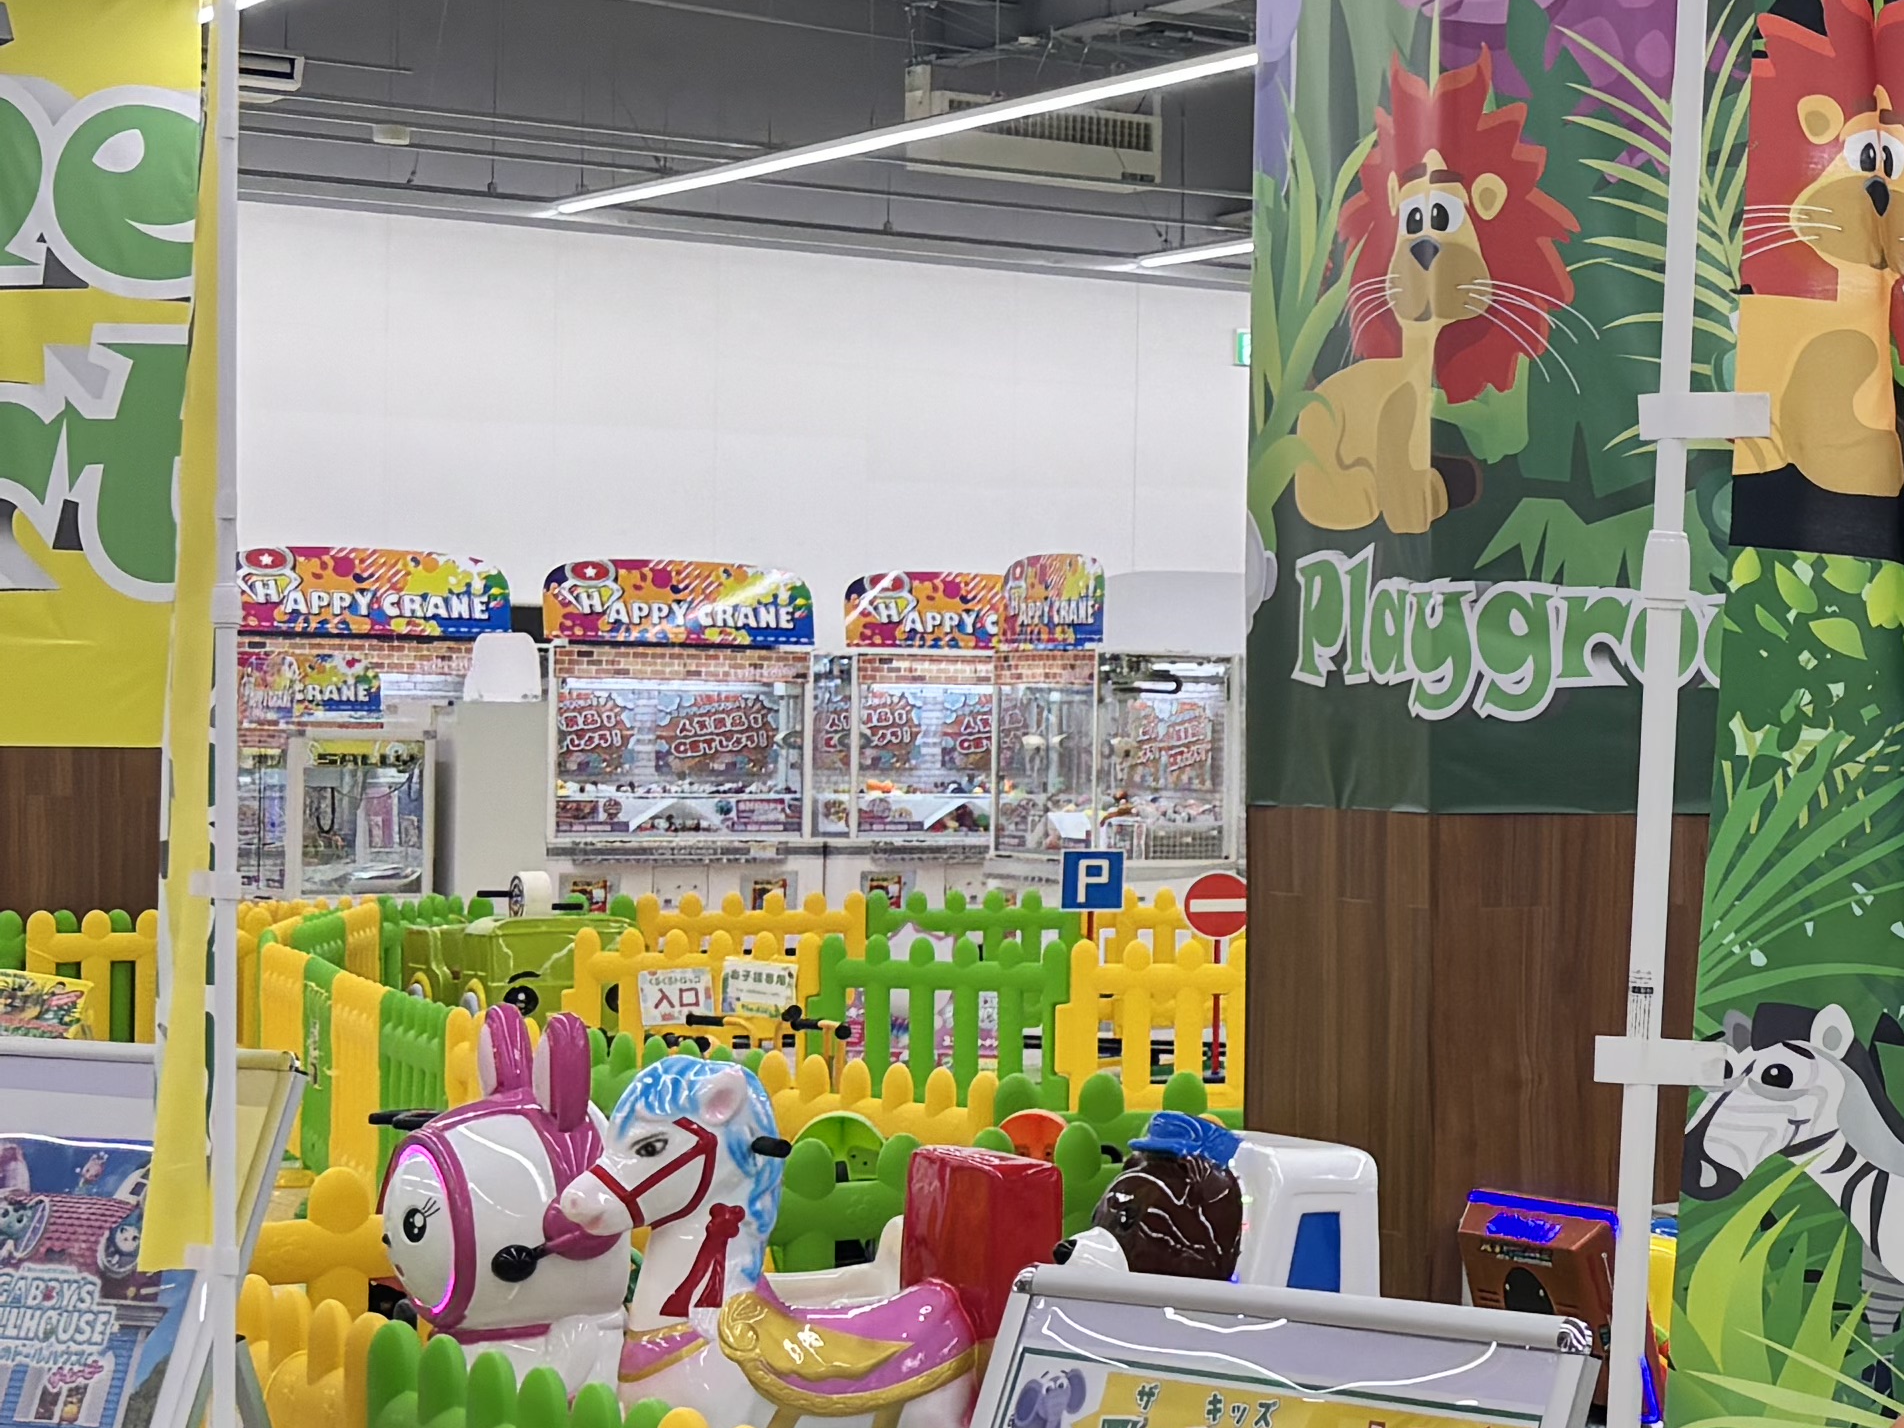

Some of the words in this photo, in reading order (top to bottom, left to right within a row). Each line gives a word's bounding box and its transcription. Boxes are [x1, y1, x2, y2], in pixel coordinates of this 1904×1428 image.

[253, 578, 374, 618] HAPPY
[383, 590, 491, 622] CRANE
[577, 591, 690, 628] HAPPY
[698, 600, 794, 632] CRANE
[878, 600, 974, 635] HAPPY
[1291, 542, 1725, 721] Playgro
[1077, 859, 1109, 903] P
[654, 987, 701, 1010] 入口
[1135, 1383, 1159, 1412] ザ
